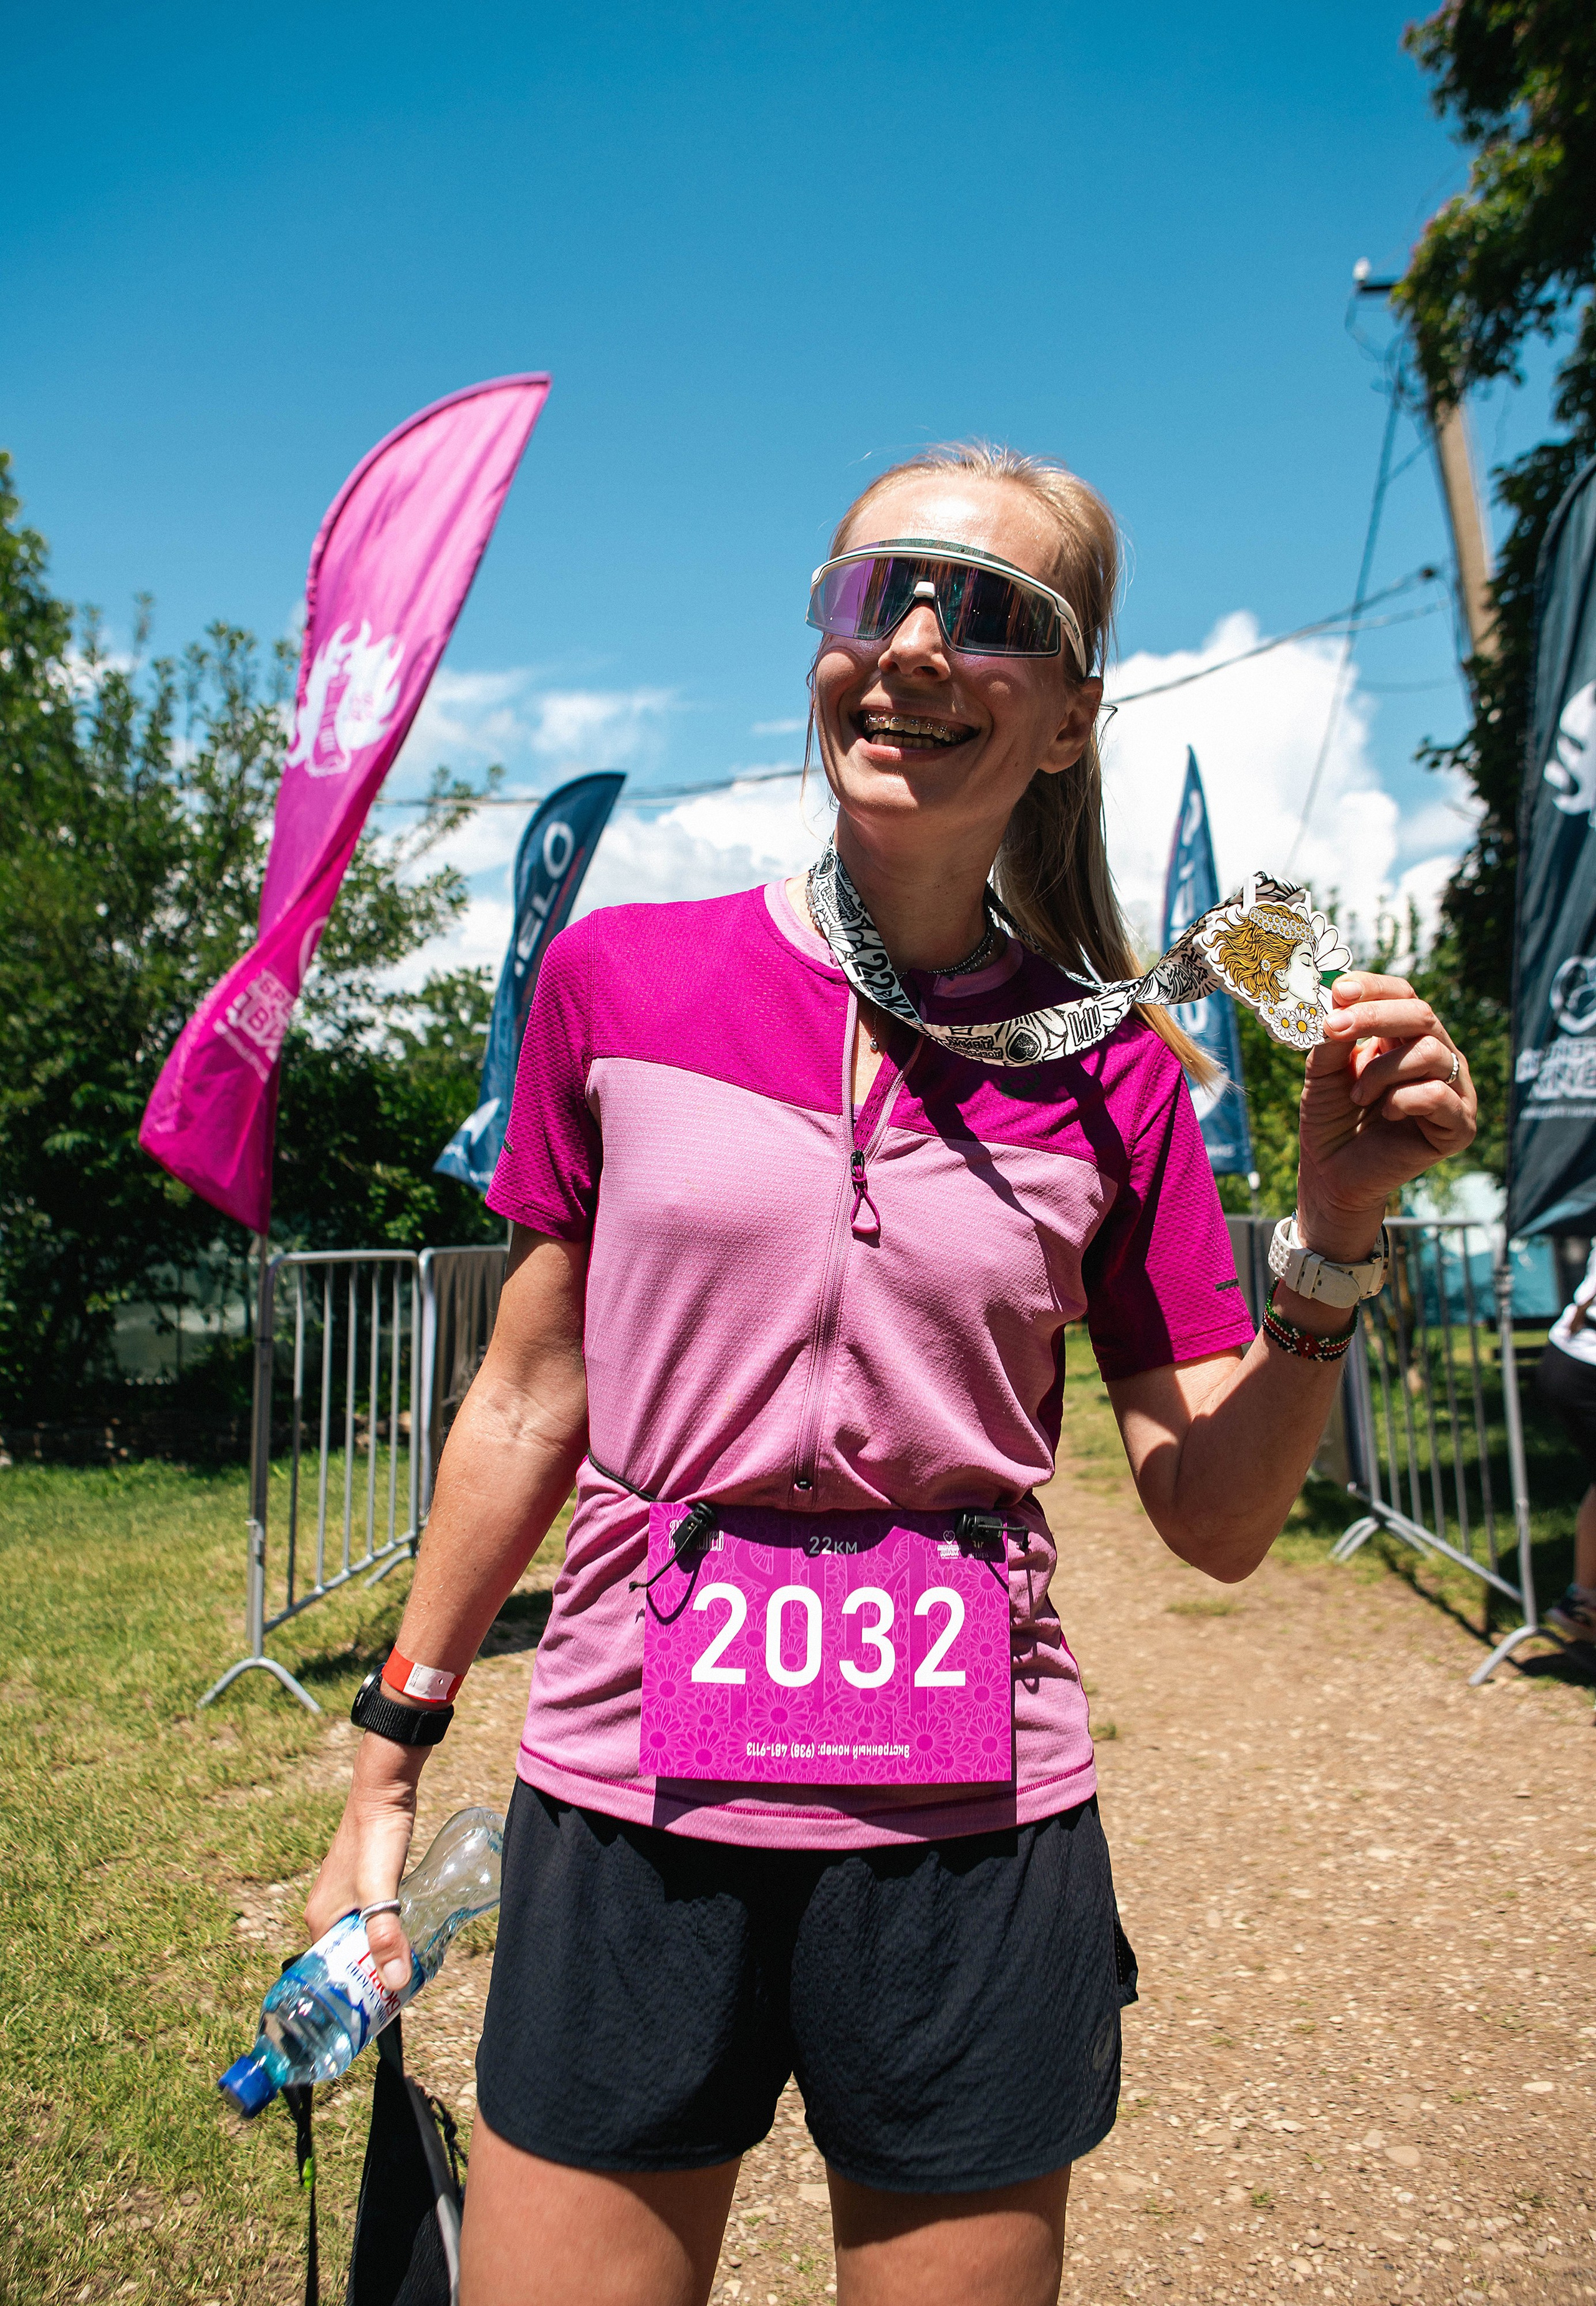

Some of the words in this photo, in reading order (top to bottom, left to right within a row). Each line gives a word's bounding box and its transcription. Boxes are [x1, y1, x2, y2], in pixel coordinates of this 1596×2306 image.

[690, 1582, 966, 1689] 2032
[746, 1742, 788, 1758] 481-9113
[791, 1742, 815, 1759] (938)
[817, 1741, 850, 1756] номер:
[852, 1742, 910, 1760] Экстренный
